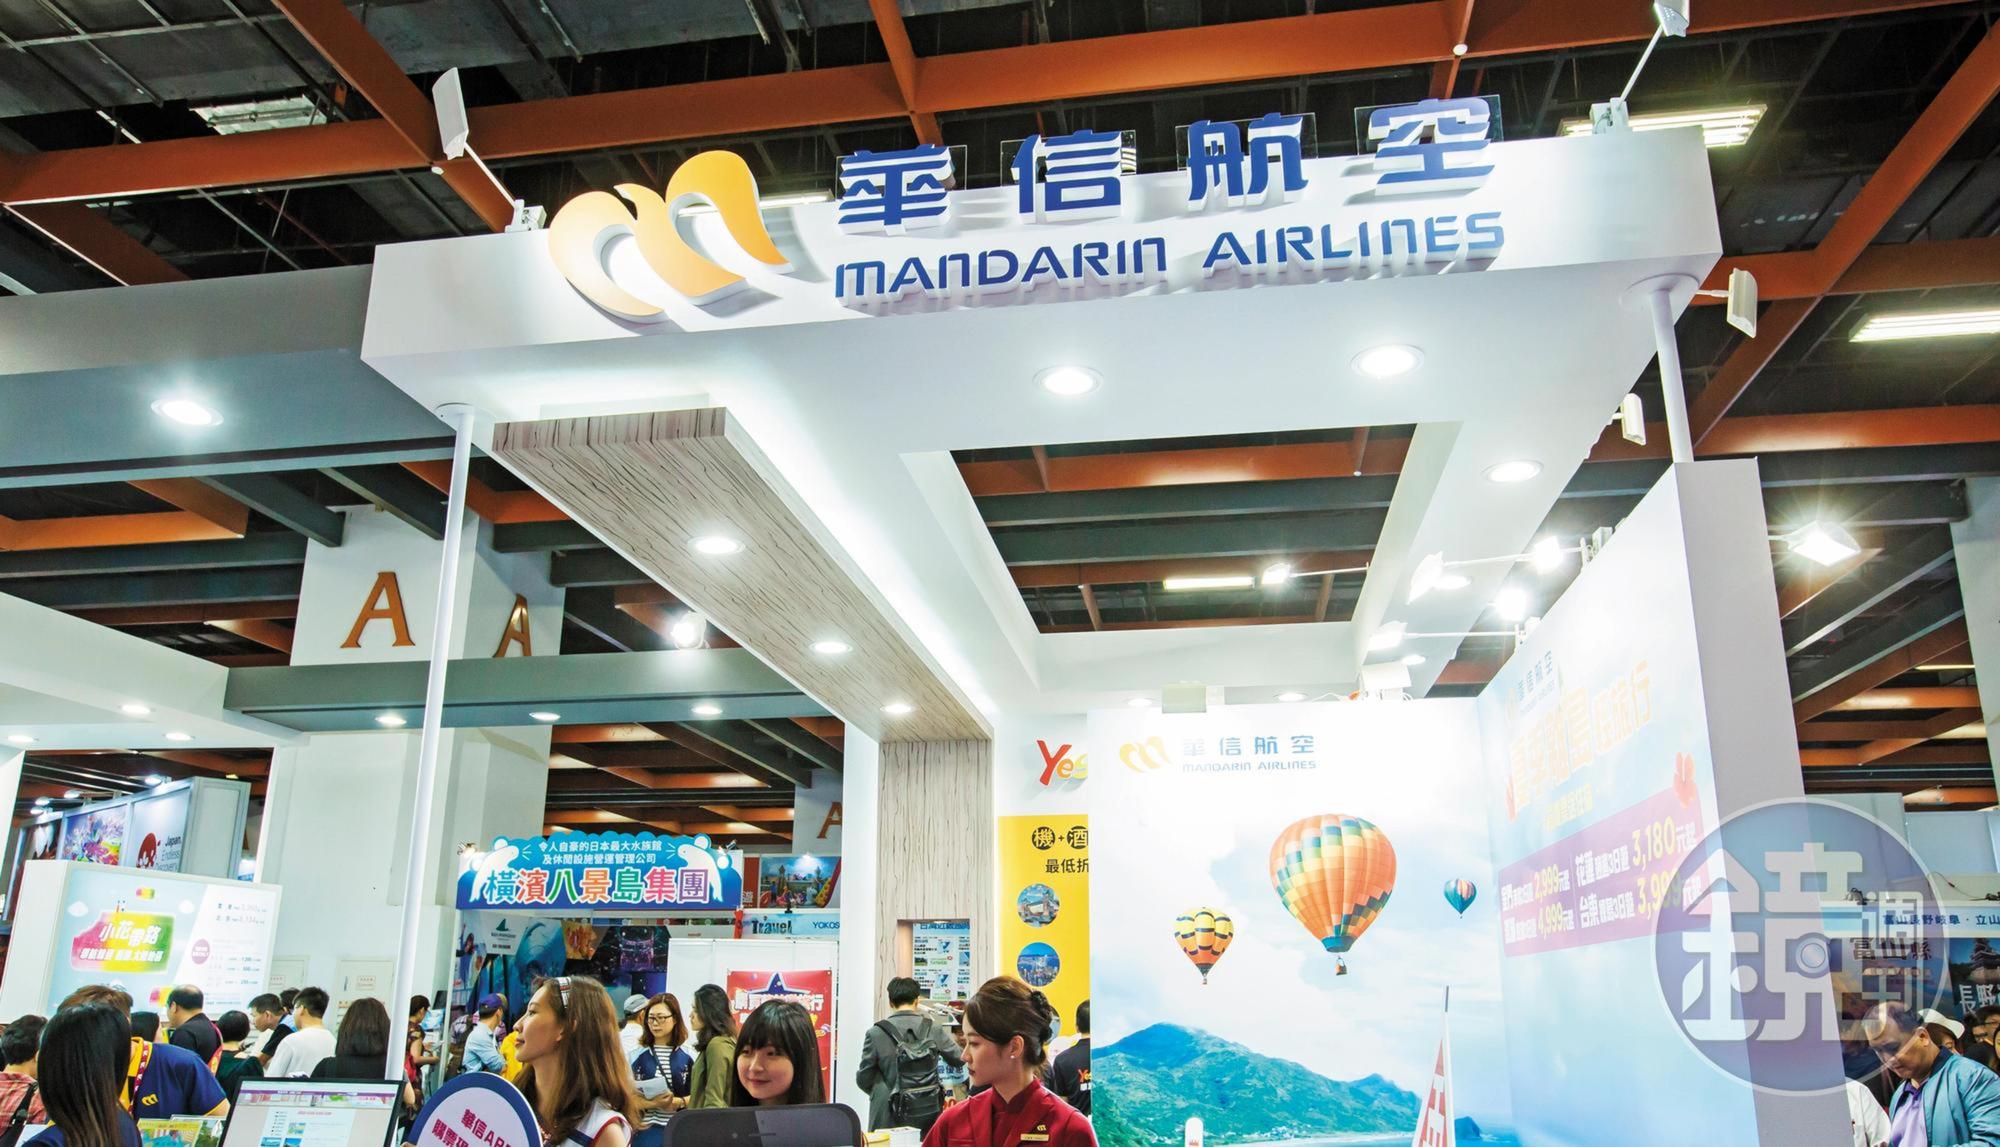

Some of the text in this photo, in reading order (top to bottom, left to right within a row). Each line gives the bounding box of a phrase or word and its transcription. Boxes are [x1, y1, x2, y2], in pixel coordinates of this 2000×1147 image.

[838, 97, 1496, 231] 華信航空
[835, 210, 1505, 298] MANDARIN AIRLINES
[340, 571, 416, 649] A
[492, 593, 532, 658] A
[1183, 735, 1315, 756] 華信航空
[1182, 760, 1317, 773] MANDARIN AIRLINES
[538, 840, 663, 852] 令人自豪的日本最大水族館
[541, 852, 657, 865] 及休閒設施營運管理公司
[1045, 858, 1088, 873] 最低折
[485, 867, 710, 904] 橫濱八景島集團
[751, 918, 793, 935] Travel
[1959, 983, 2000, 1018] 長野
